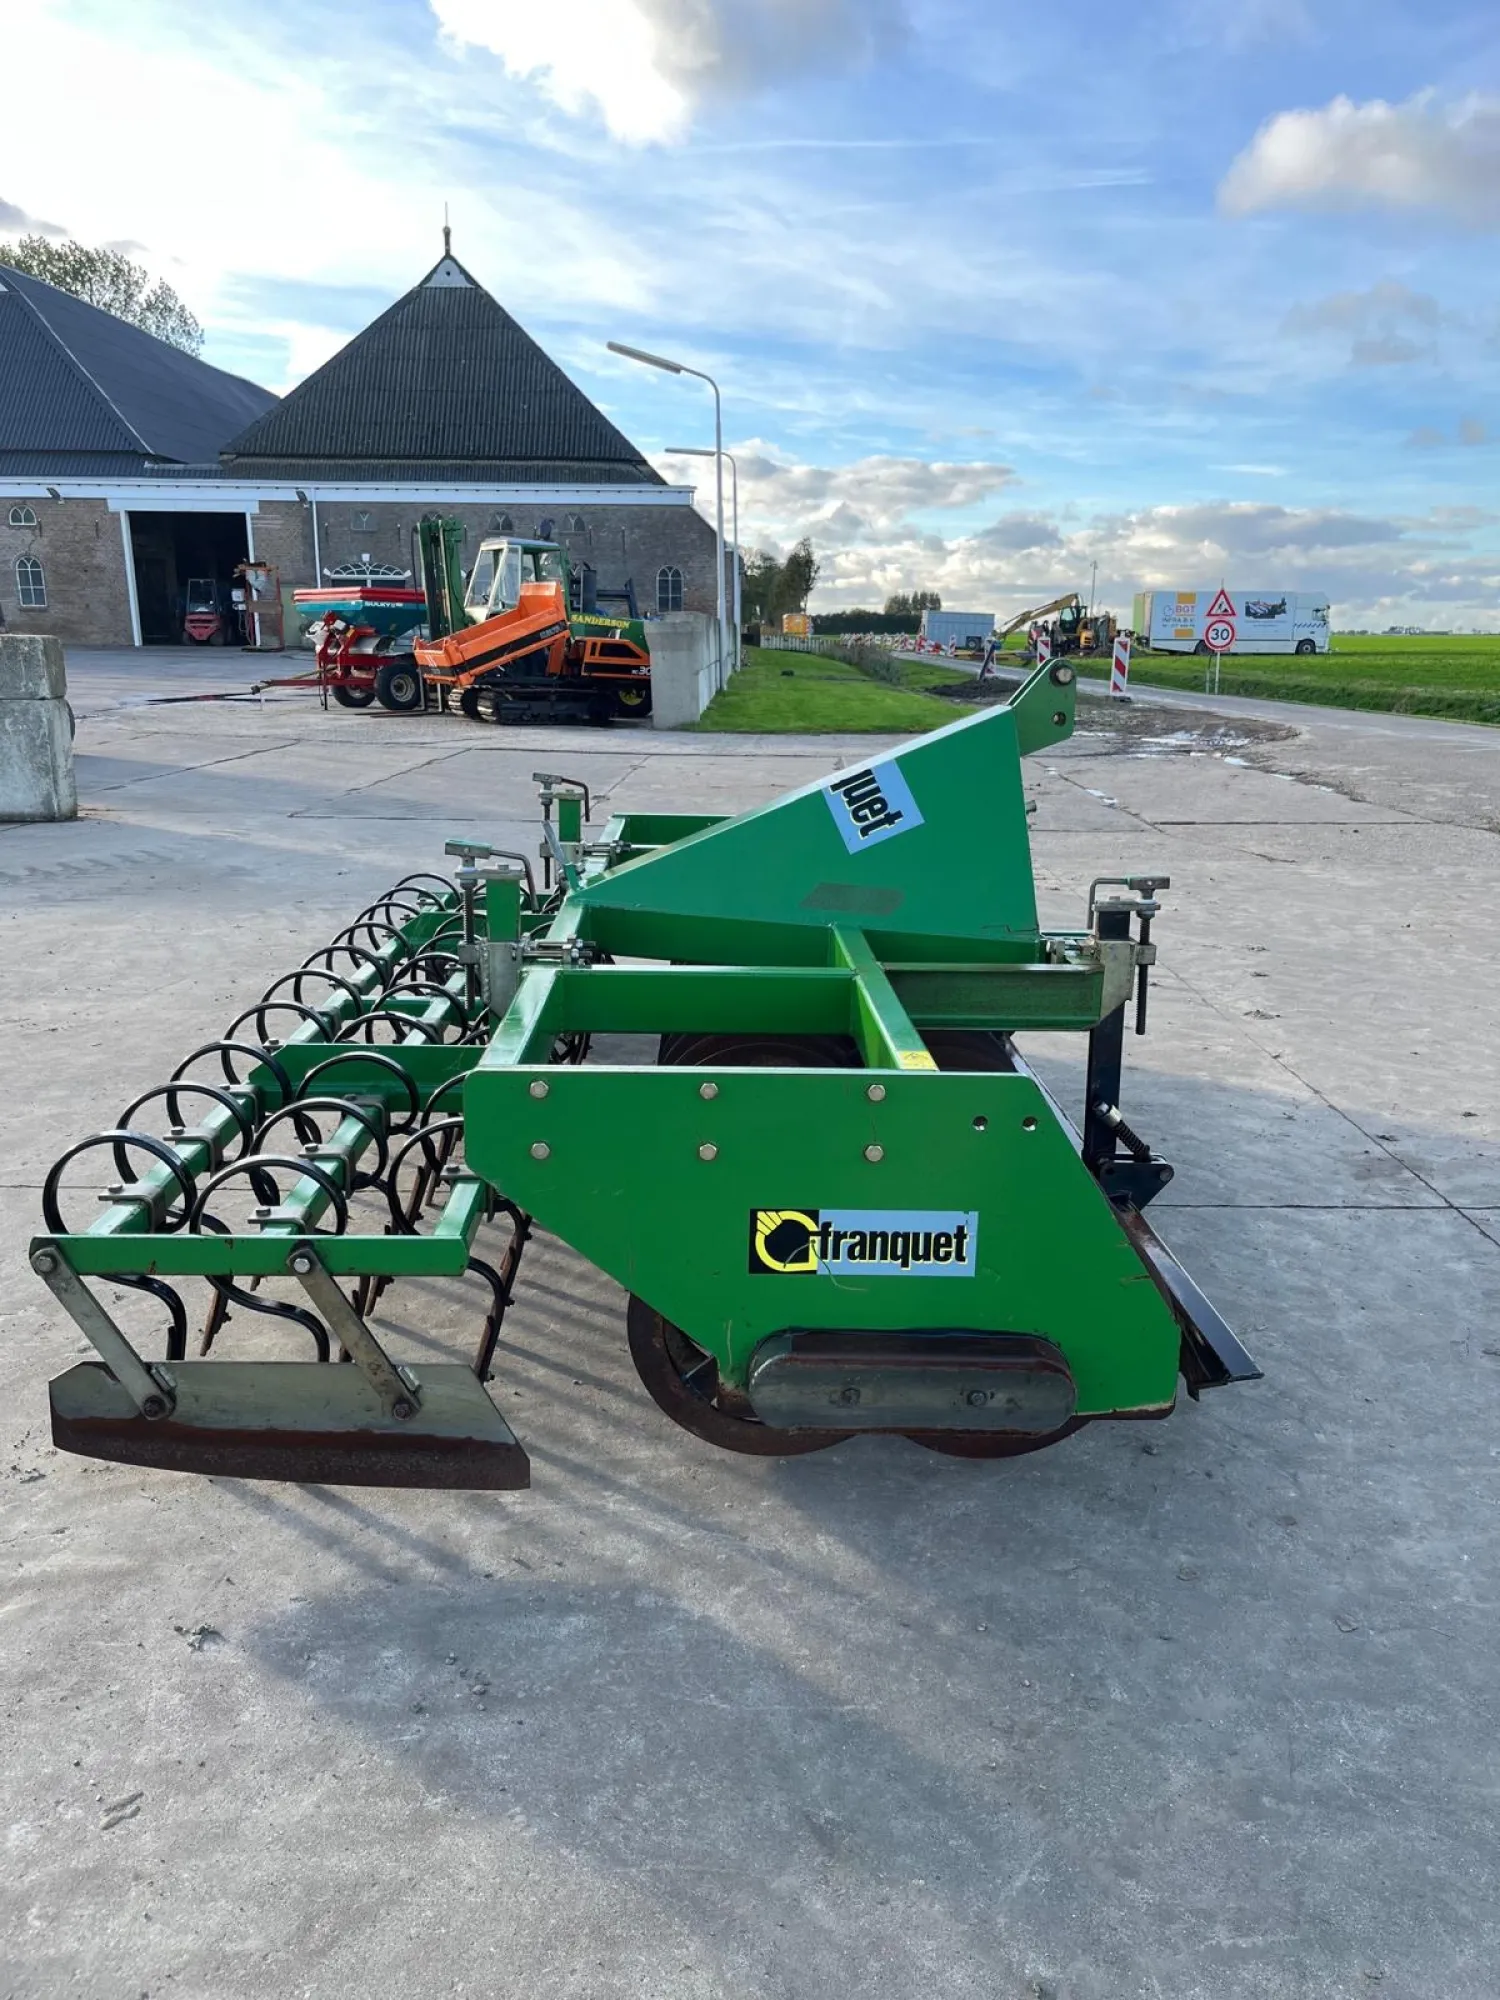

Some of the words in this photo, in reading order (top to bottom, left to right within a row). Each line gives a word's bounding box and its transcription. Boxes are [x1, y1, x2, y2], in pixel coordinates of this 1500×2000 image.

[571, 614, 631, 629] SANDERSON
[1211, 628, 1230, 641] 30
[815, 1220, 968, 1270] franquet
